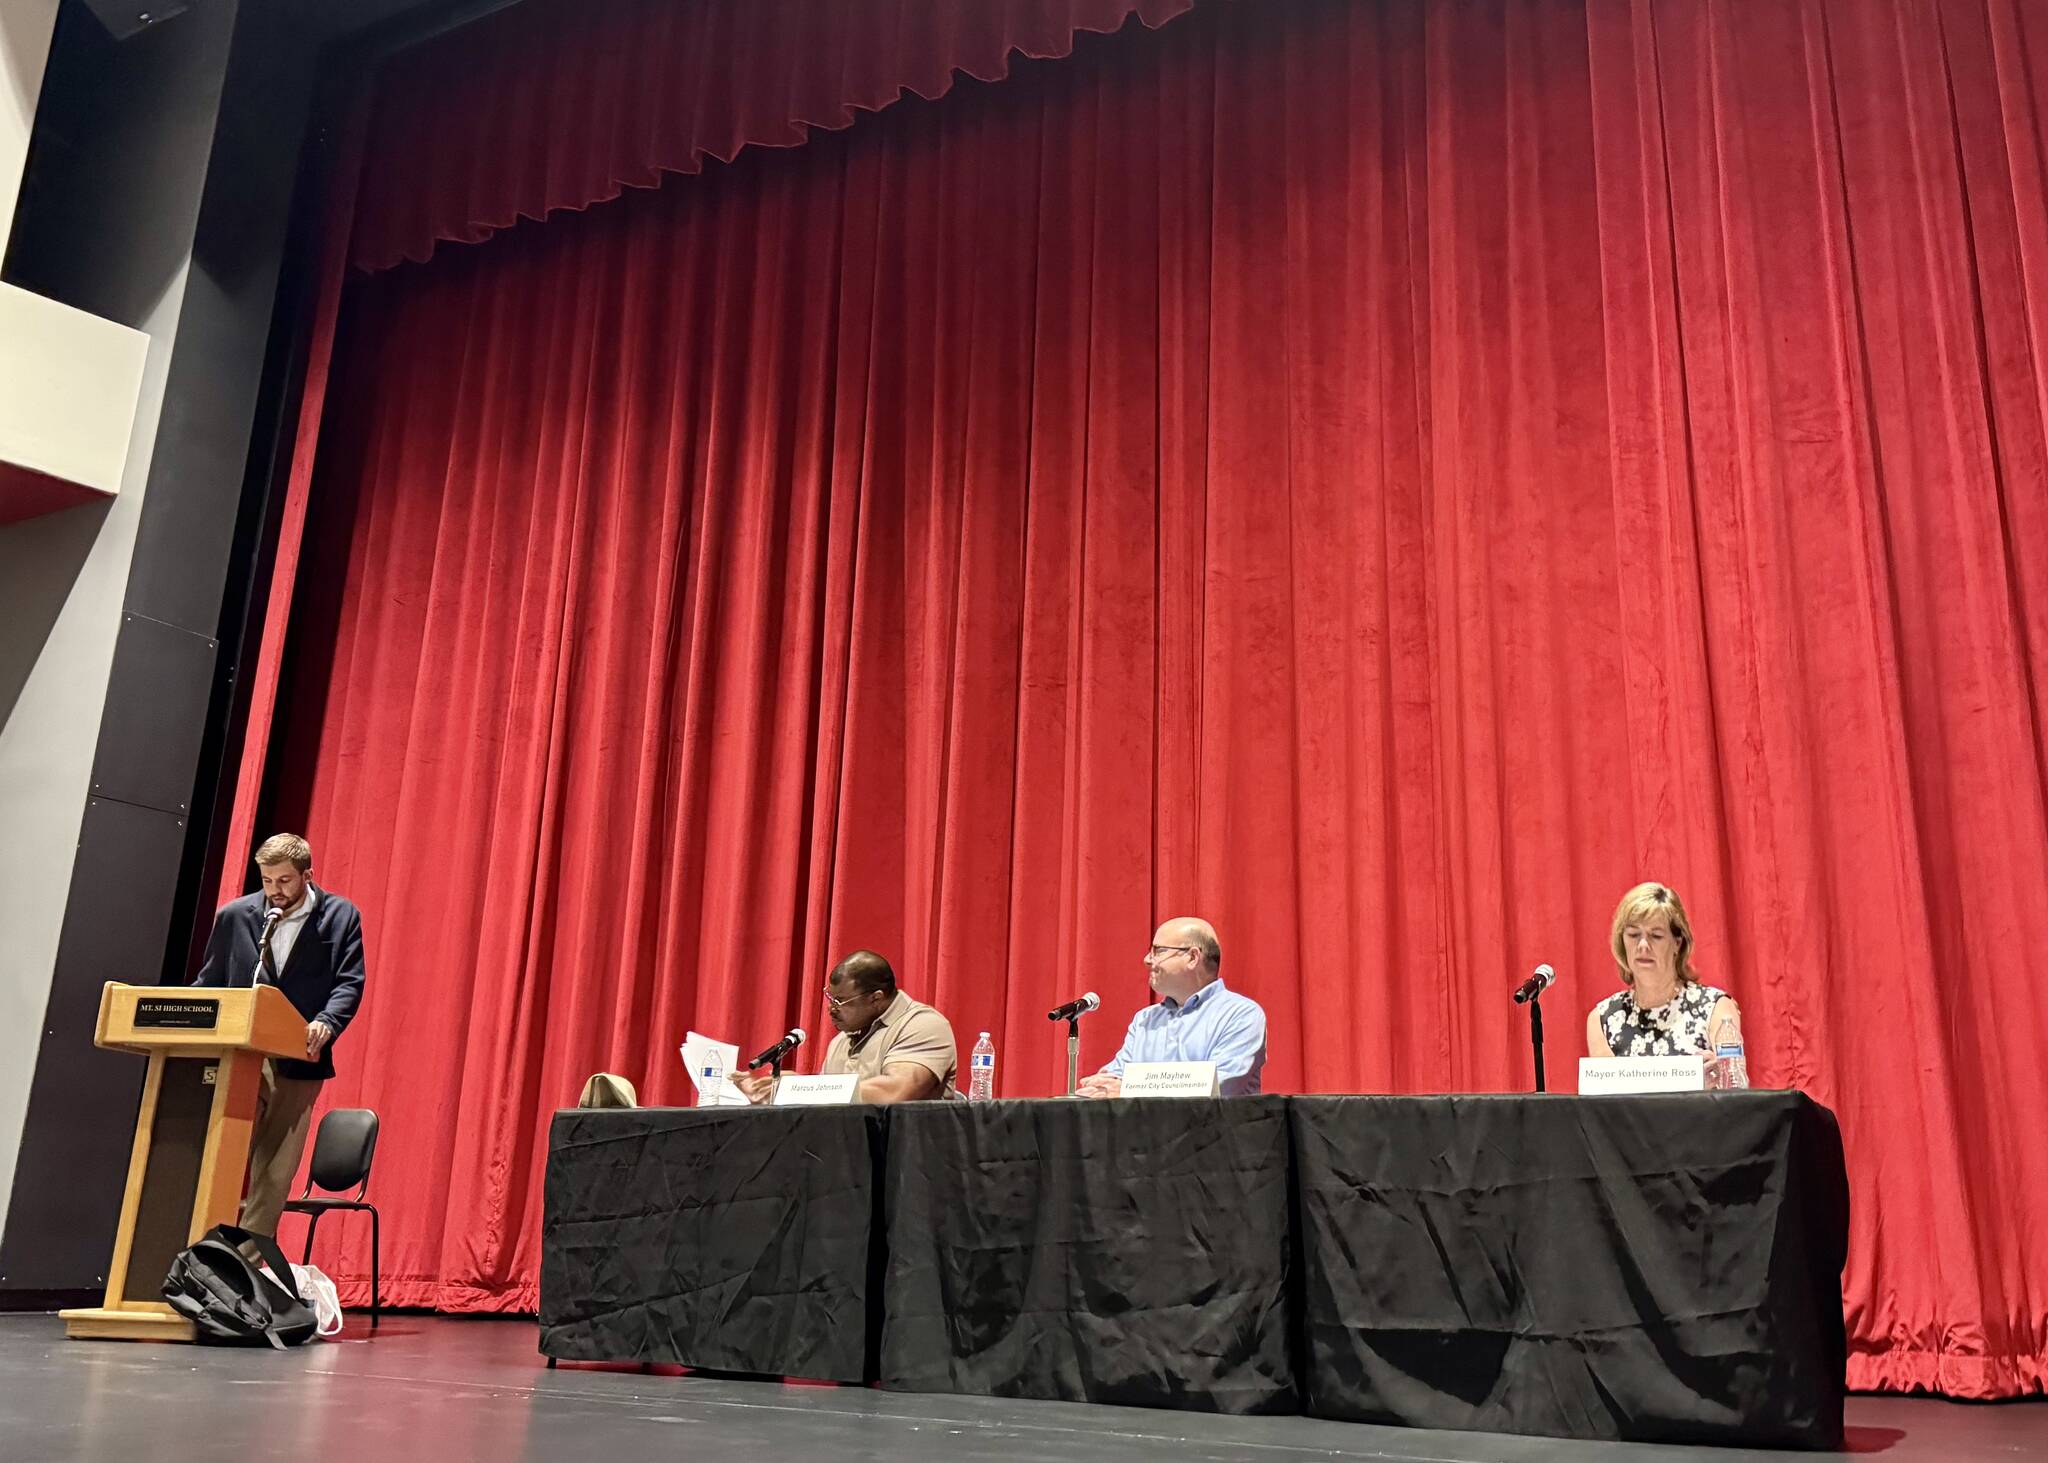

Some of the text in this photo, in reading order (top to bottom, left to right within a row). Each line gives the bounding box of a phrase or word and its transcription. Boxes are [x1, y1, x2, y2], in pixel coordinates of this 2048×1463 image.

[141, 1004, 153, 1012] MT.
[1145, 1072, 1191, 1080] Jim Mayhew
[1585, 1068, 1697, 1080] Mayor Katherine Ross
